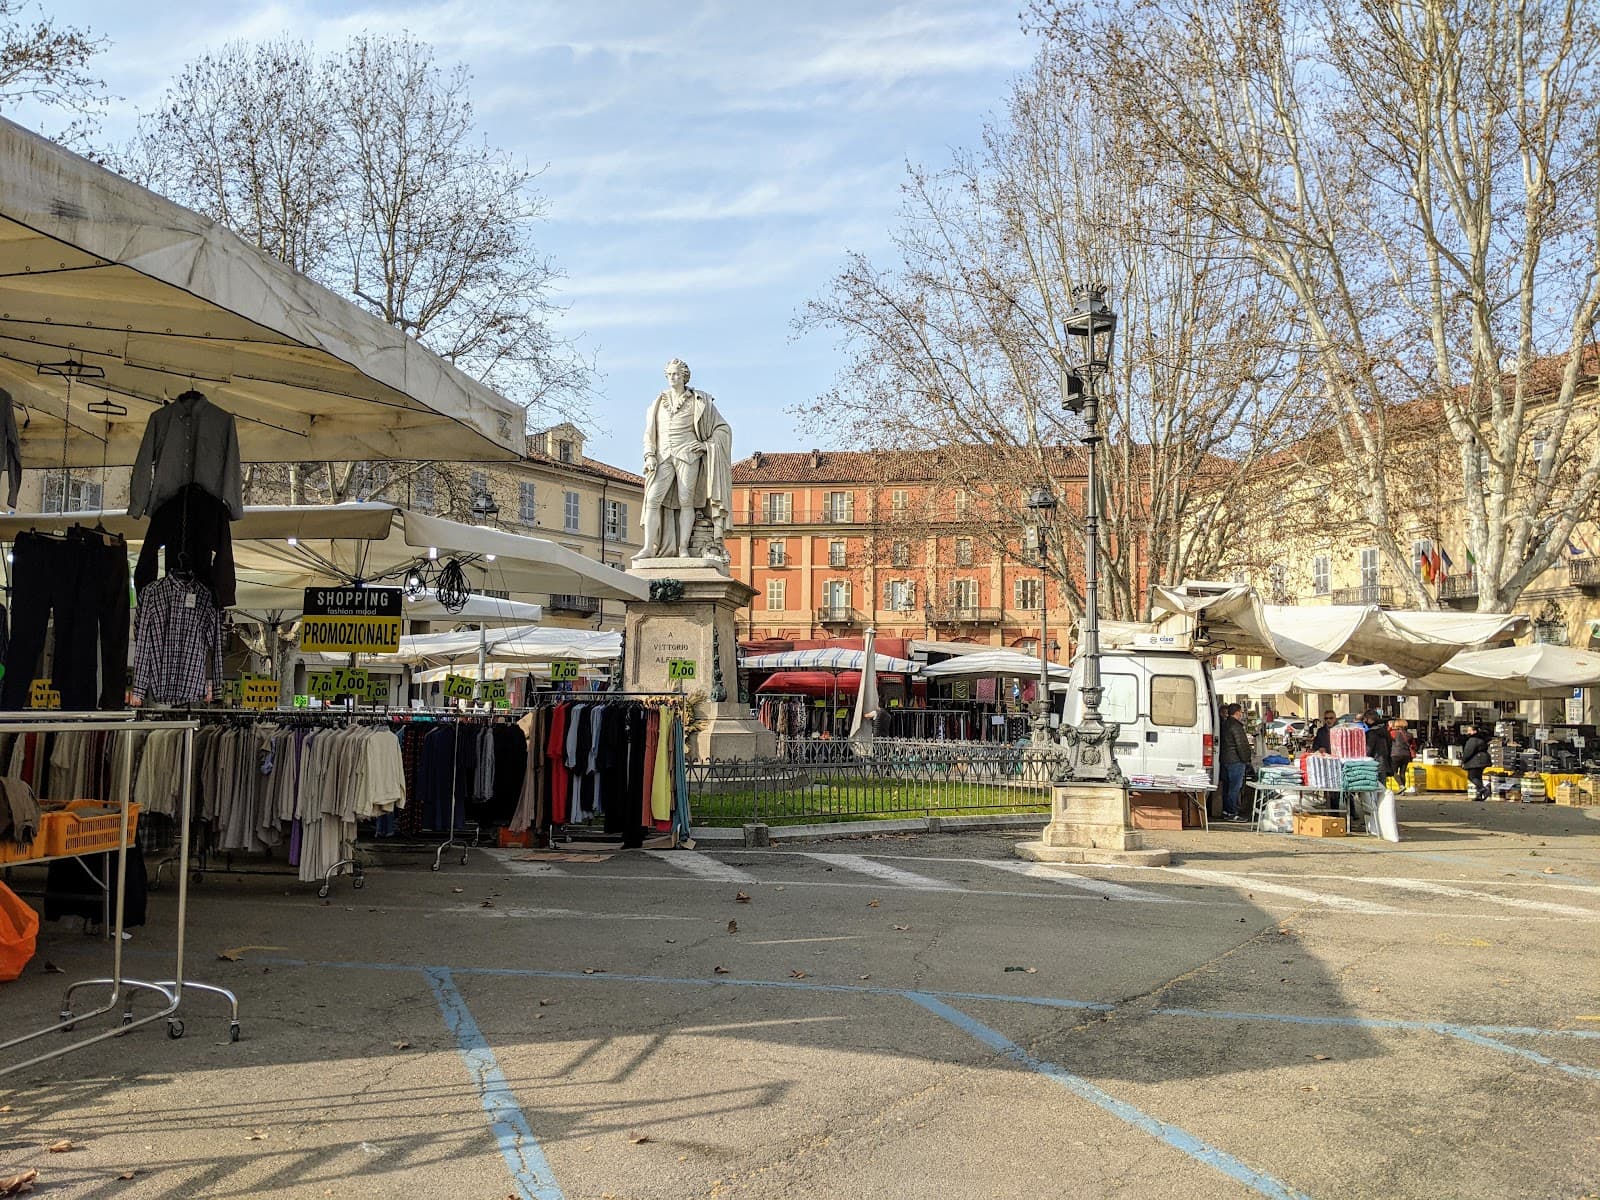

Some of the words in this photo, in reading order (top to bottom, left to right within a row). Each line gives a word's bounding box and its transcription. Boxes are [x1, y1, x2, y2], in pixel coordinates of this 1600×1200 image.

[317, 591, 389, 606] SHOPPING
[327, 606, 354, 615] fashion
[303, 622, 398, 645] PROMOZIONALE
[653, 643, 689, 651] VITTORIO
[554, 663, 577, 678] 7,00
[671, 662, 694, 676] 7,00
[335, 671, 365, 691] 7,00
[447, 677, 472, 696] 7,00
[366, 684, 388, 697] 7,00
[483, 685, 505, 699] 7,00
